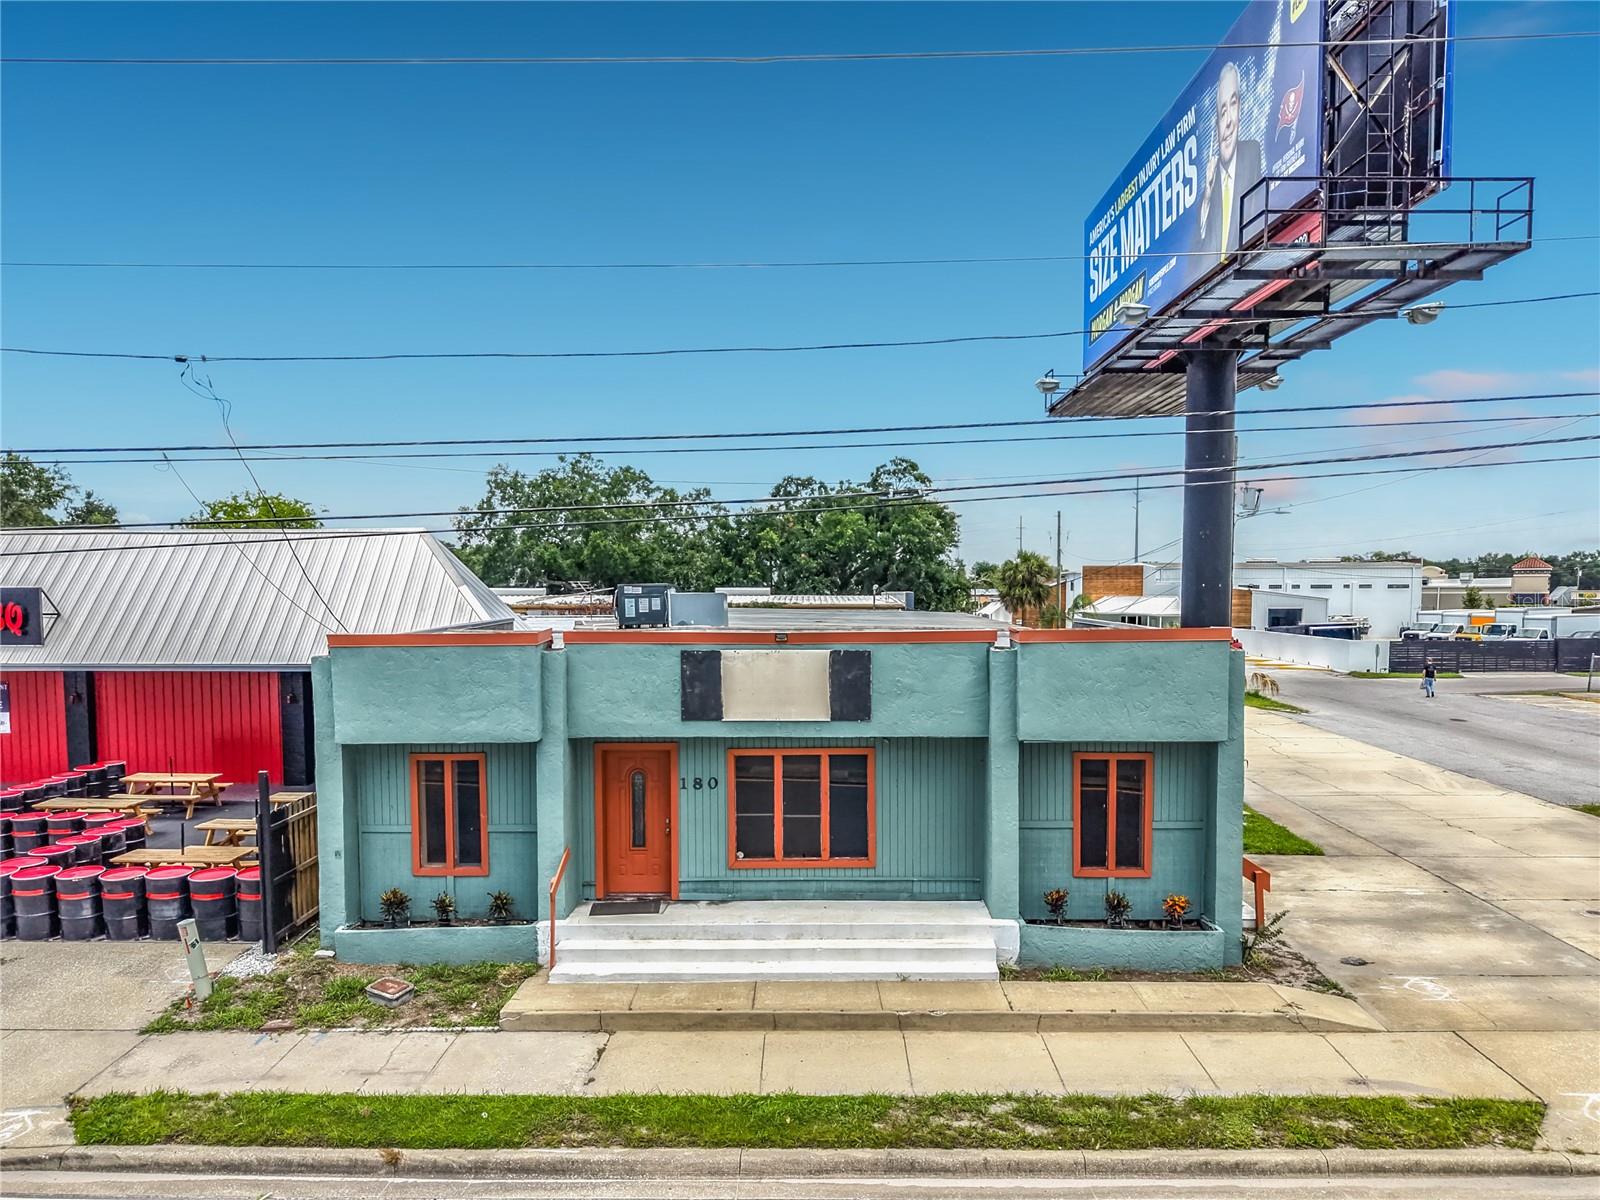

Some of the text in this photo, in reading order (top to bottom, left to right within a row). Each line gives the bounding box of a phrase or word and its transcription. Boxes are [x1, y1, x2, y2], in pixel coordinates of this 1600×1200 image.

[1114, 175, 1139, 216] LARGEST
[1138, 147, 1160, 188] INJURY
[1161, 128, 1176, 160] LAW
[1176, 107, 1196, 142] FIRM
[1090, 224, 1118, 303] SIZE
[1120, 135, 1198, 274] MATTERS
[0, 601, 23, 636] Q
[680, 777, 718, 790] 180
